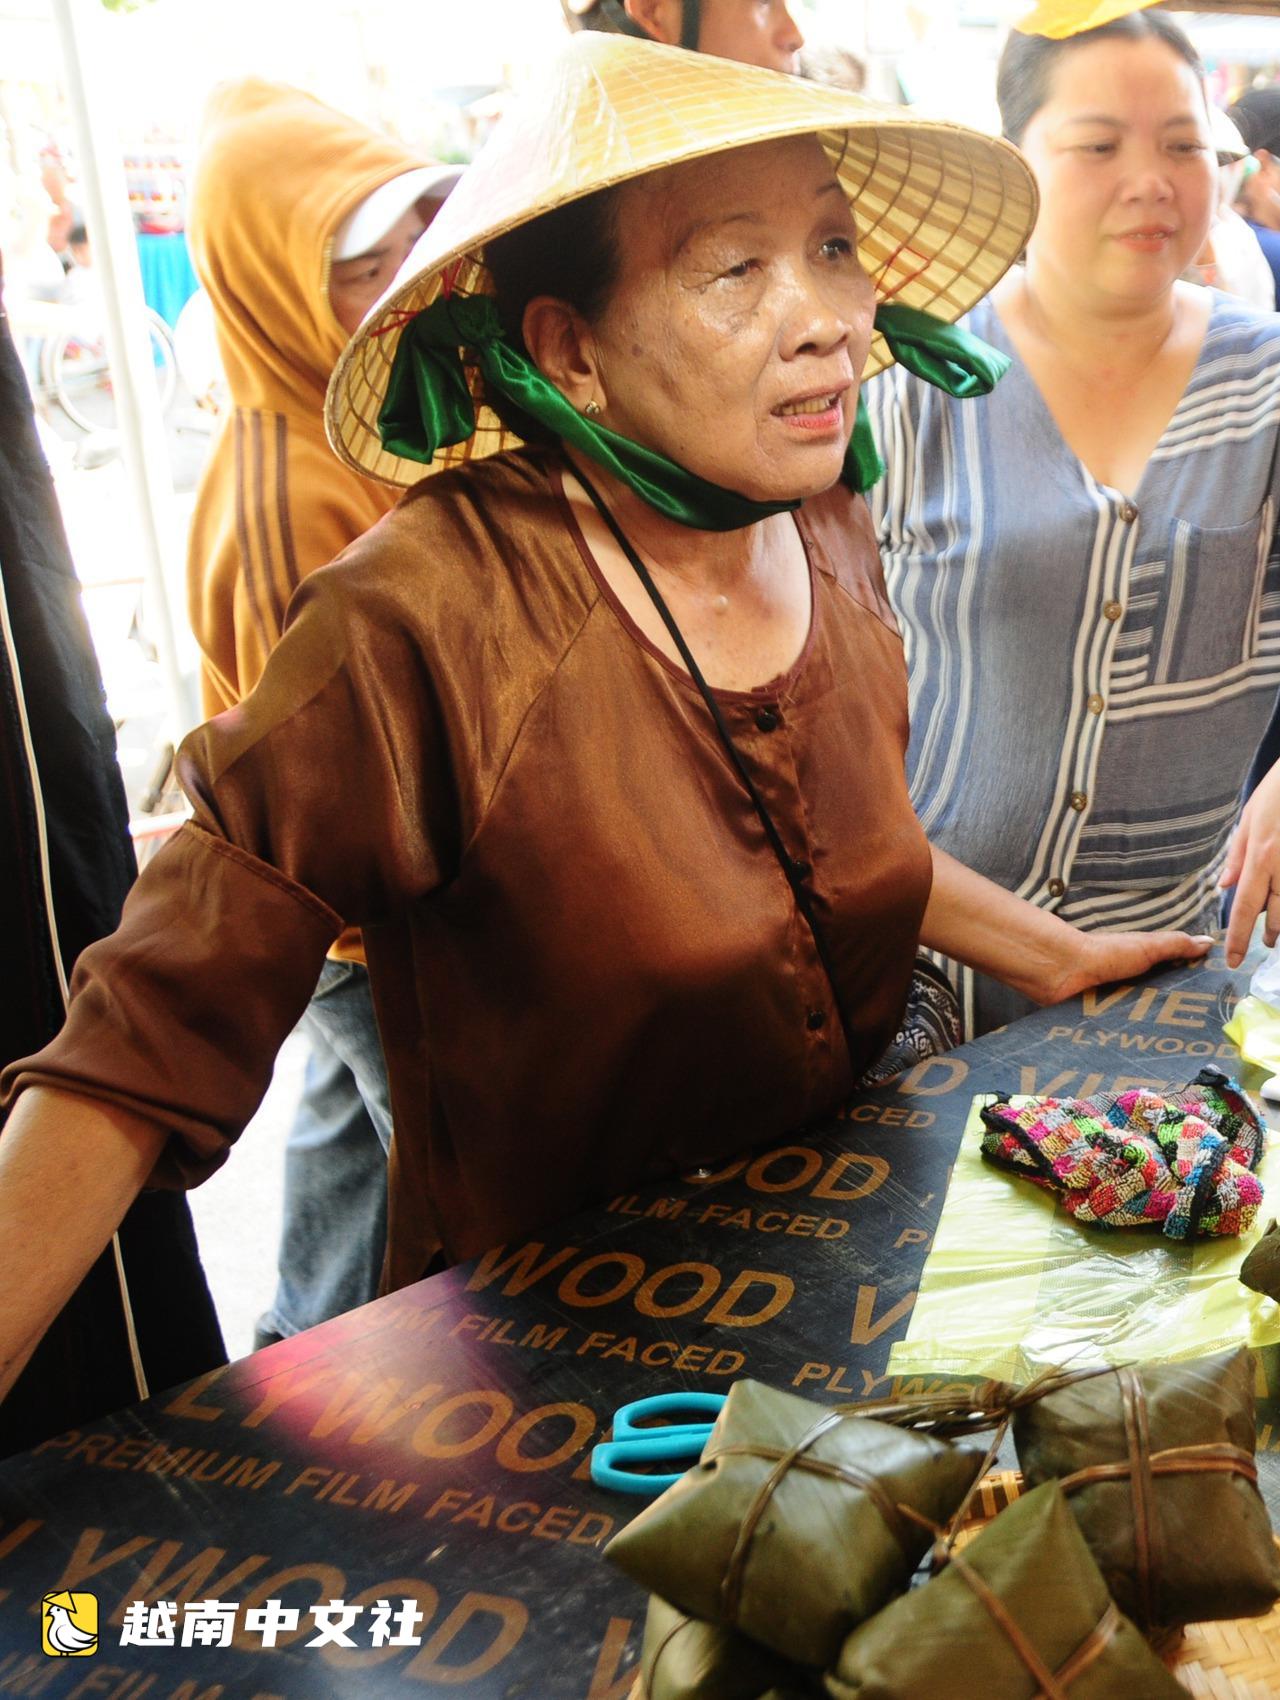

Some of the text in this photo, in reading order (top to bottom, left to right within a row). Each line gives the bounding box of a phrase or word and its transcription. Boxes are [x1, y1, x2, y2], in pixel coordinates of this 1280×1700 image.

[697, 1202, 850, 1240] FACED
[449, 1313, 570, 1351] FILM
[576, 1331, 747, 1375] FACED
[32, 1430, 617, 1545] PREMIUM FILM FACED
